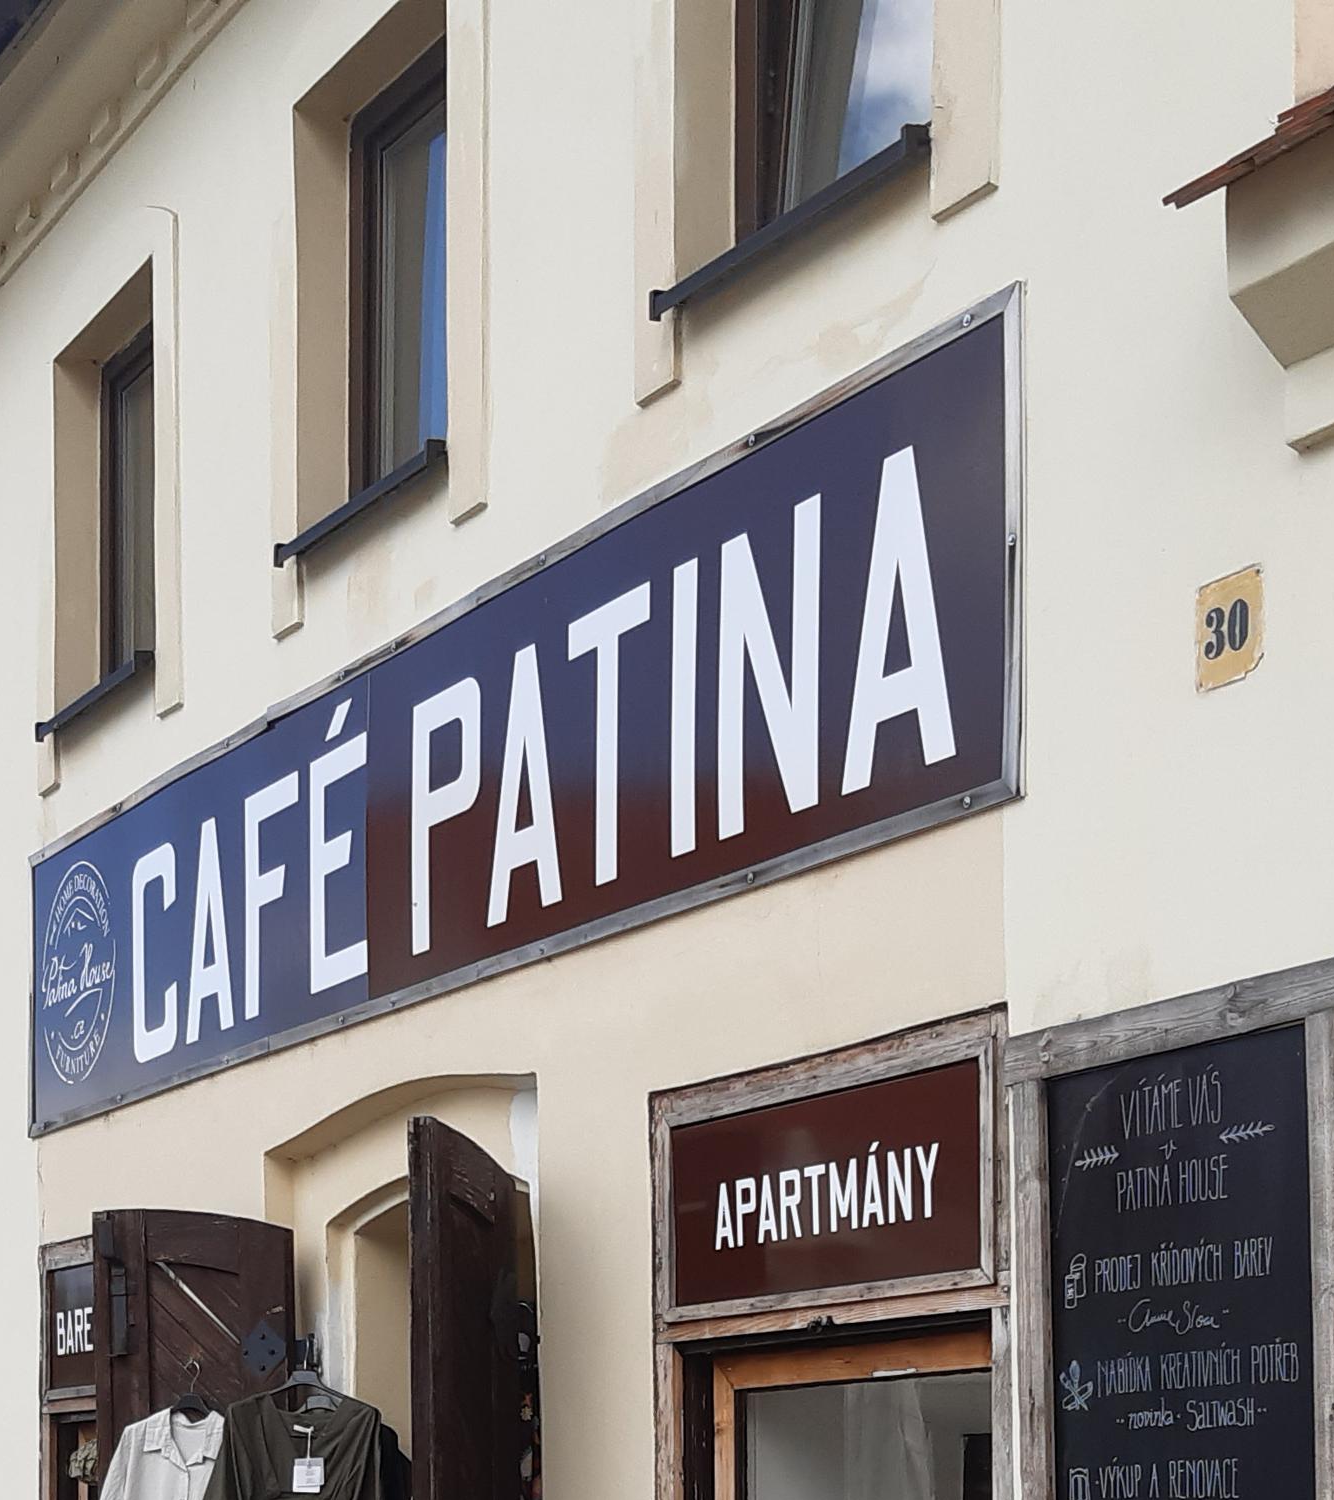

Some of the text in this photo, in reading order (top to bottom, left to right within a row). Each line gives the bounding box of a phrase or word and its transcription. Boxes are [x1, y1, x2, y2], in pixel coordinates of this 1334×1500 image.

[1204, 598, 1249, 660] 30
[132, 446, 955, 1063] CAFÉ PATINA
[79, 943, 115, 991] House
[55, 1028, 101, 1076] FURNITURE
[1120, 1063, 1221, 1140] VÍTÁME VÁS
[715, 1141, 939, 1250] APARTMÁNY
[1179, 1154, 1229, 1204] HOUSE
[1094, 1236, 1273, 1293] PRODEJ KŘÍDOVÝCH BAREV
[56, 1307, 94, 1356] BARE
[1097, 1337, 1299, 1398] NABÍDKA KREATIVNÍCH POTŘEB
[1098, 1457, 1240, 1499] VÝKUP A RENOVACE
